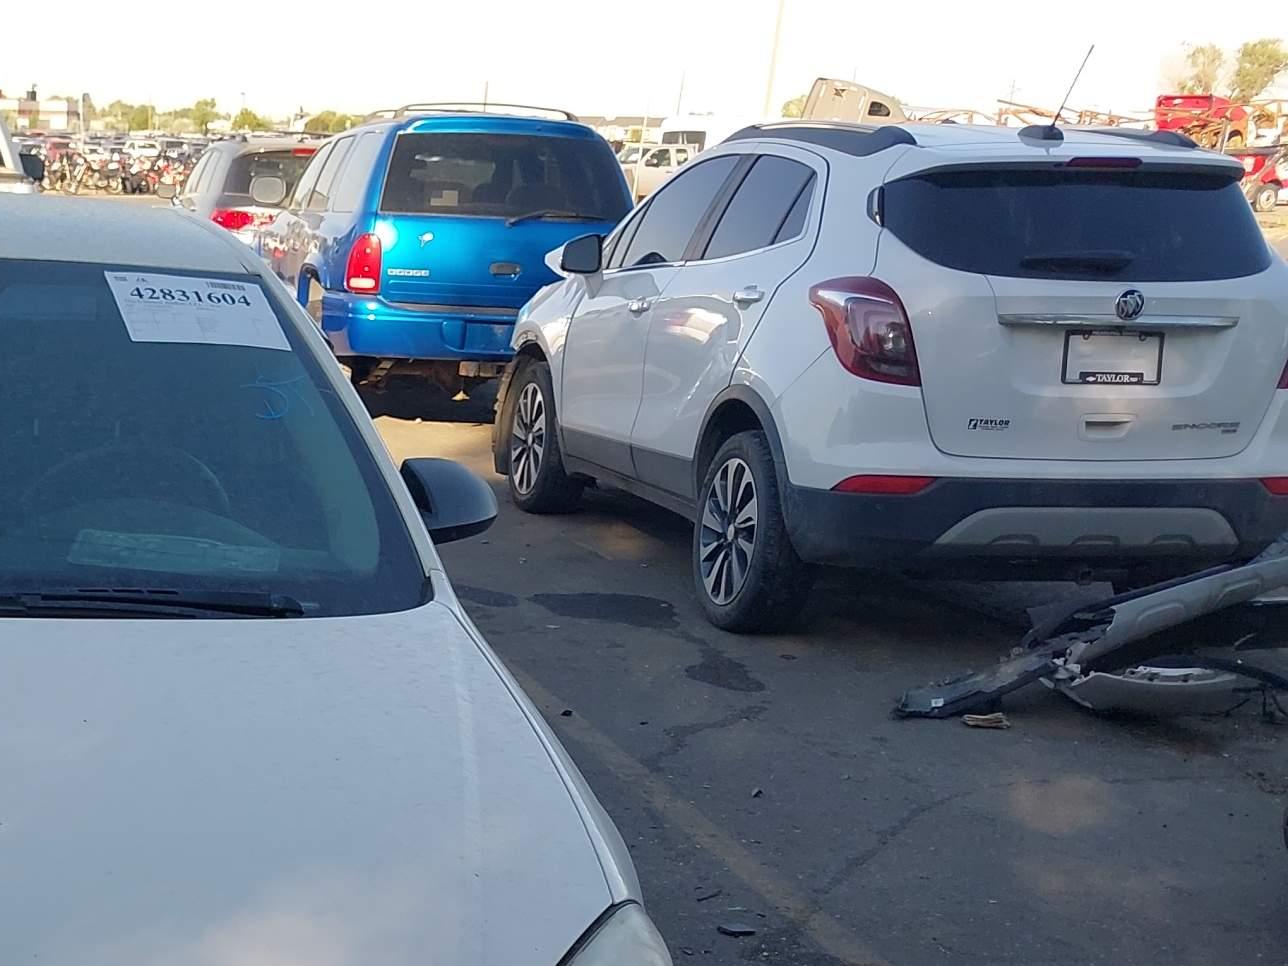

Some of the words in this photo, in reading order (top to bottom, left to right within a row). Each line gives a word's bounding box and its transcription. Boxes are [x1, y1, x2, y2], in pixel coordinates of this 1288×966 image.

[130, 286, 251, 306] 42831604
[1095, 374, 1130, 383] TAYLOR
[979, 418, 1011, 426] TAYLOR
